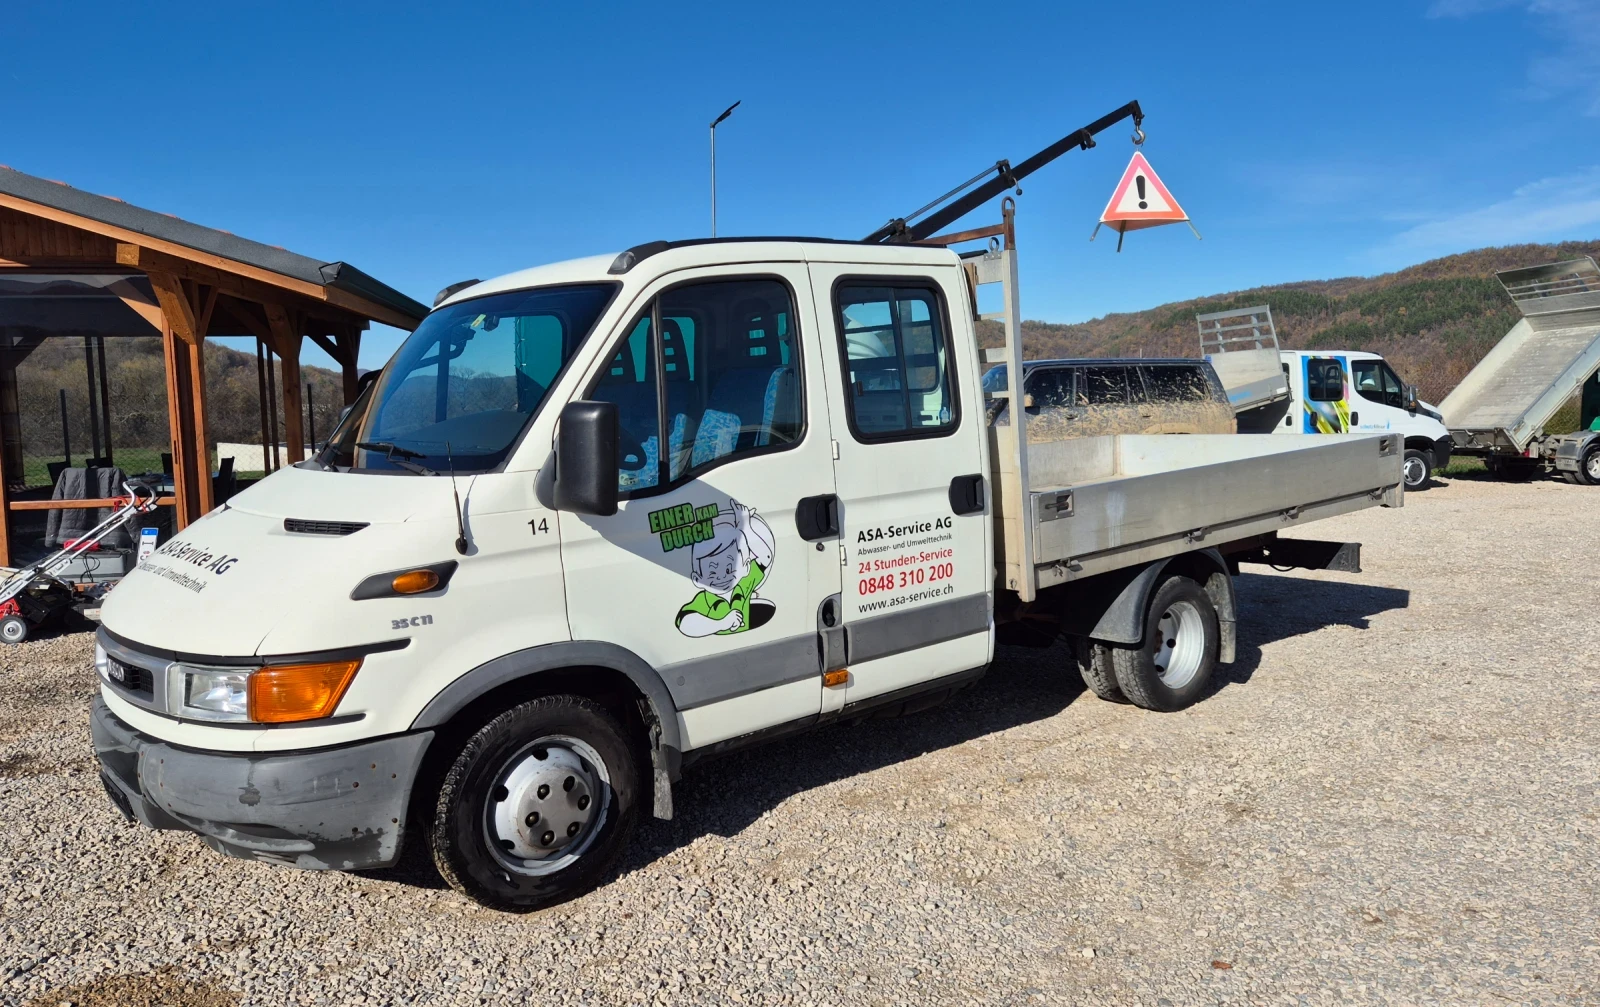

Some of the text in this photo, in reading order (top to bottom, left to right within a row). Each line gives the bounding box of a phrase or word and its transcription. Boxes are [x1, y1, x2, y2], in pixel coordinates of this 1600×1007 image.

[527, 517, 549, 536] 14
[648, 502, 719, 534] EINER KAM
[857, 516, 952, 544] ASA-Service AG
[660, 519, 715, 553] DURCH
[857, 532, 953, 556] Abwasser- und Umwelttechnik
[204, 554, 239, 575] AG
[858, 547, 953, 574] 24 Stunden-Service
[858, 562, 953, 596] 0848 310 200
[858, 583, 954, 613] www.asa-service.ch
